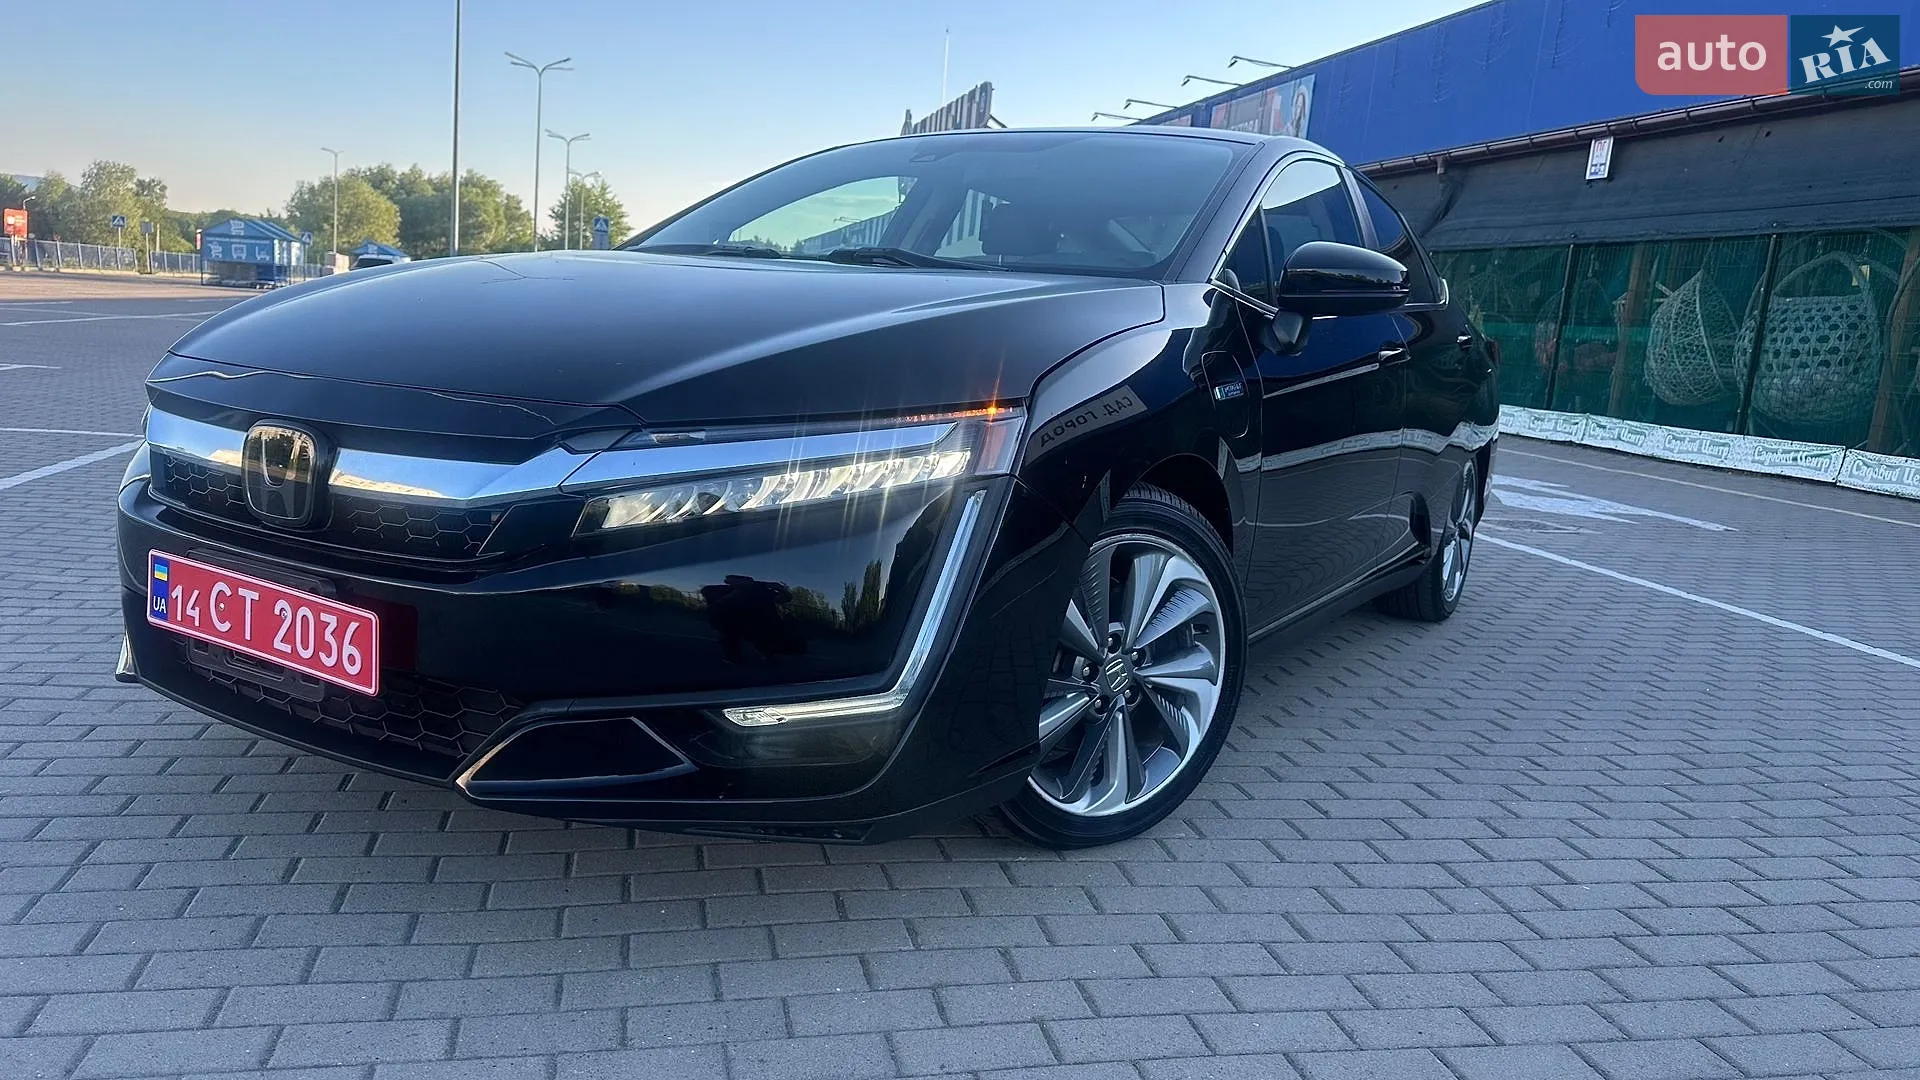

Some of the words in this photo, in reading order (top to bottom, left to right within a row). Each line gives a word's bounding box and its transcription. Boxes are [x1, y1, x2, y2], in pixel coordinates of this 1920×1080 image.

[153, 595, 167, 614] UA
[171, 584, 200, 627] 14
[209, 581, 260, 641] CT
[273, 599, 362, 676] 2036
